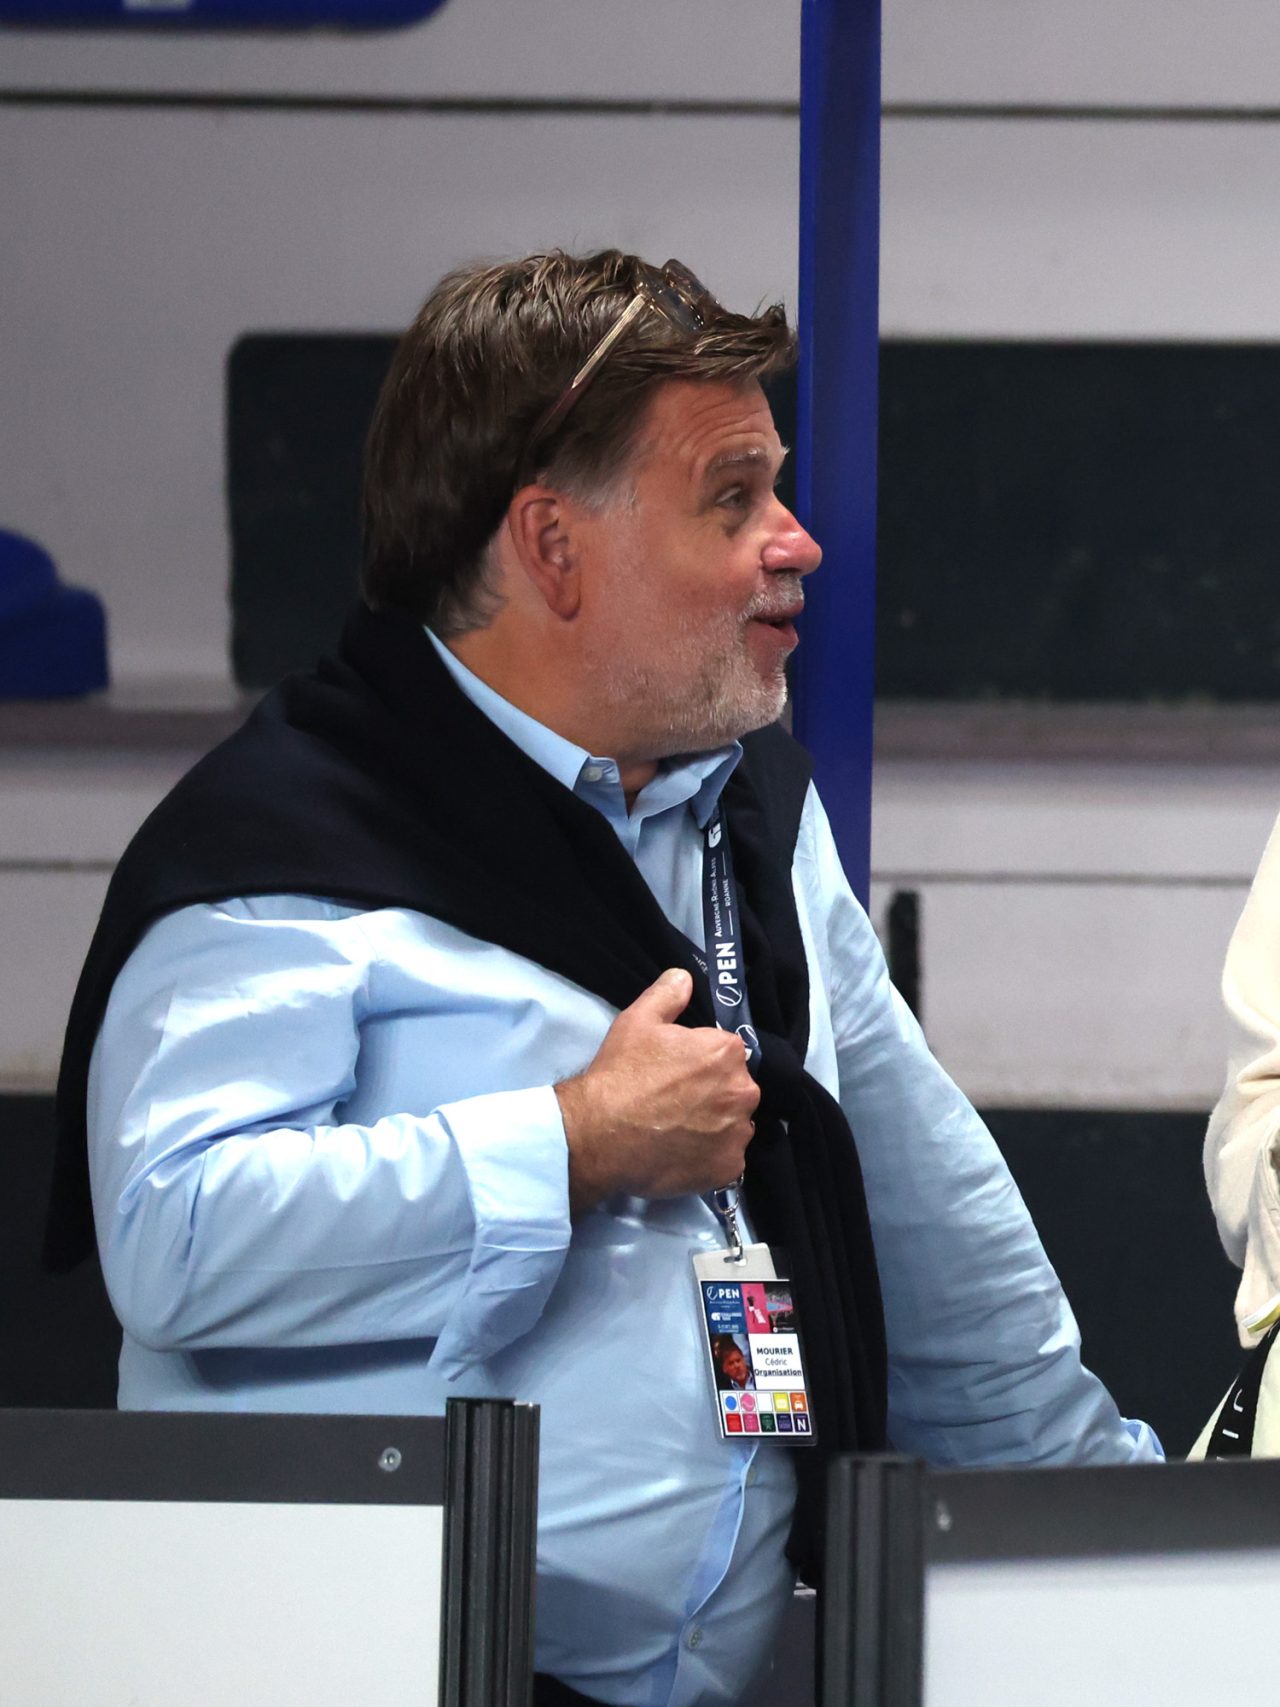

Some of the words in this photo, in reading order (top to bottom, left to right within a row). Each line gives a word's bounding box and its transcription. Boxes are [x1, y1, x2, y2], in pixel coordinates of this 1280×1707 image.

[757, 1347, 794, 1355] MOURIER
[765, 1357, 788, 1366] Cédric
[754, 1368, 803, 1377] Organisation
